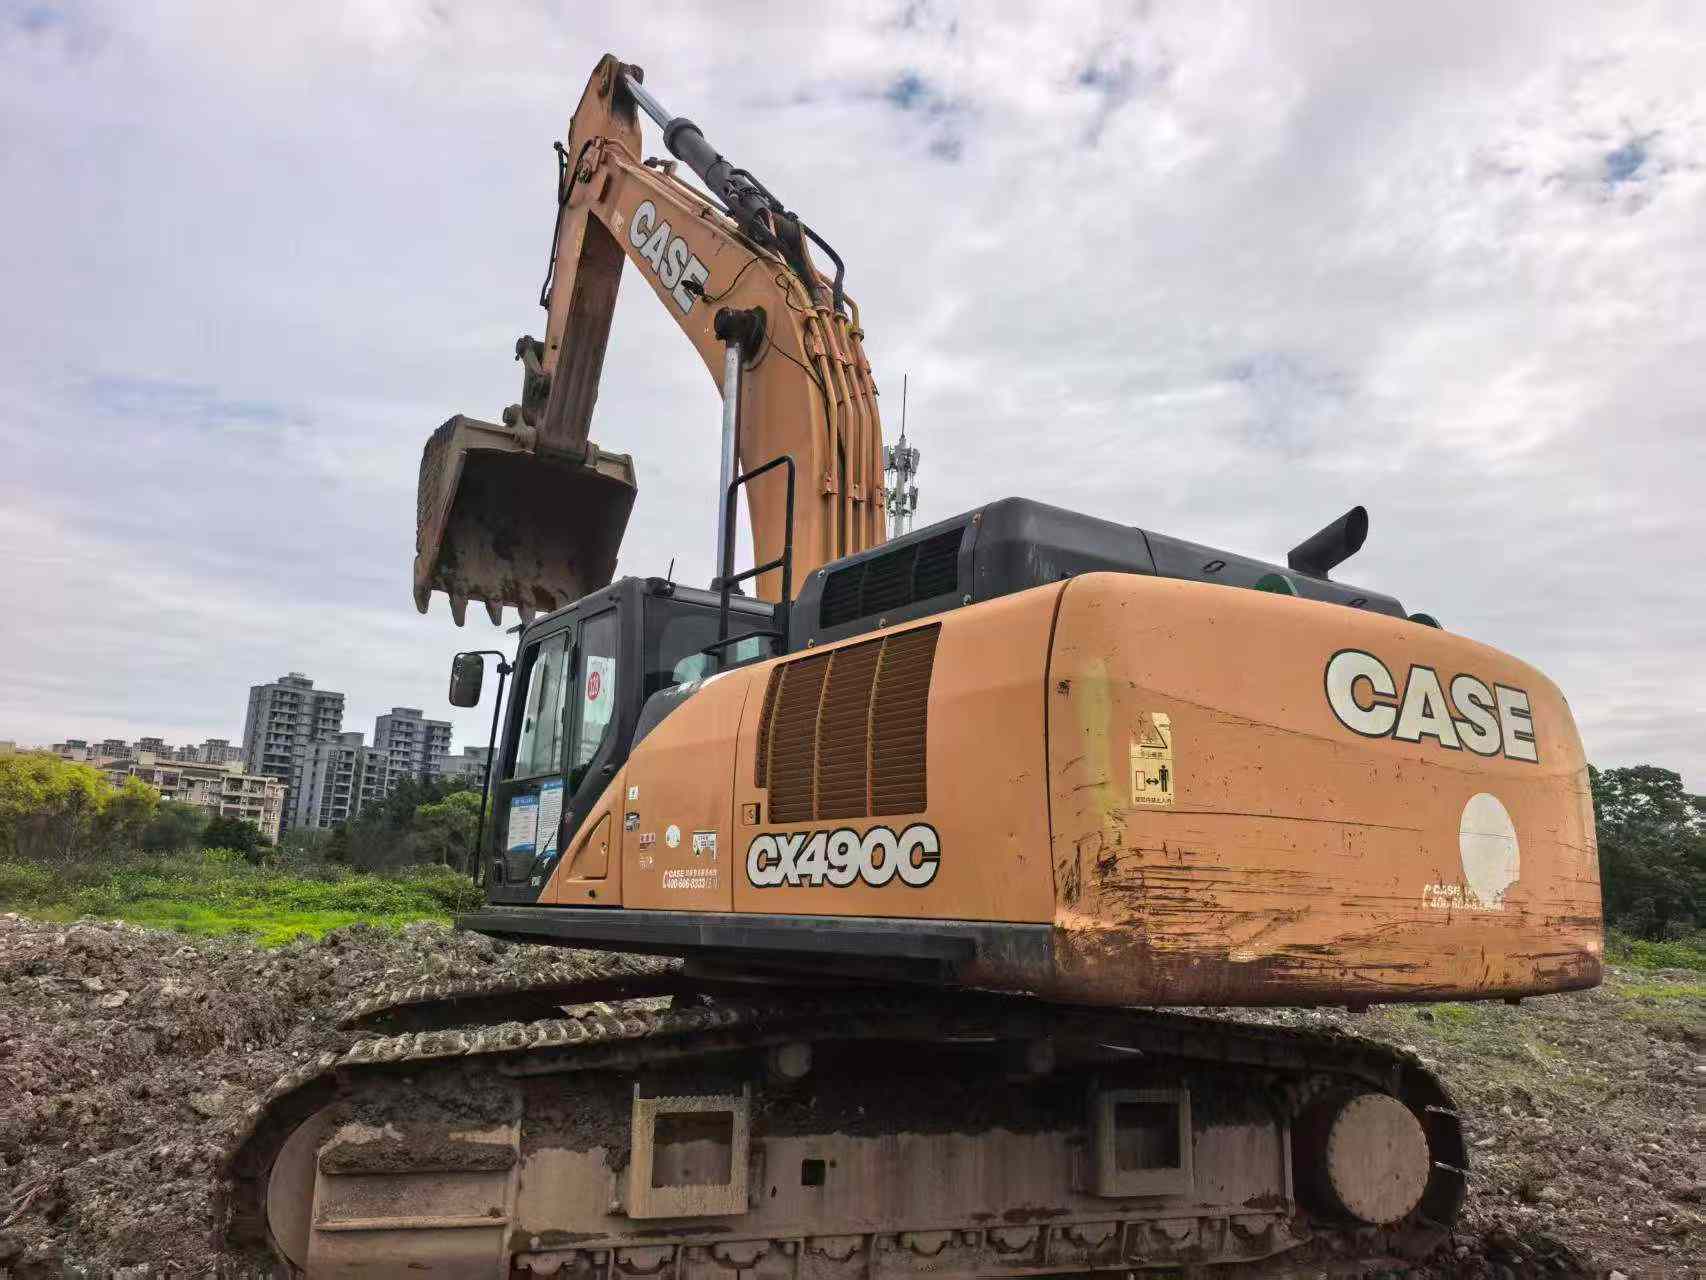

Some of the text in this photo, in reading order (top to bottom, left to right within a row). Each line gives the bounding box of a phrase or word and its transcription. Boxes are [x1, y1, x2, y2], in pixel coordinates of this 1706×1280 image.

[630, 200, 710, 314] CASE
[1323, 648, 1539, 764] CASE
[746, 822, 941, 888] CX490C
